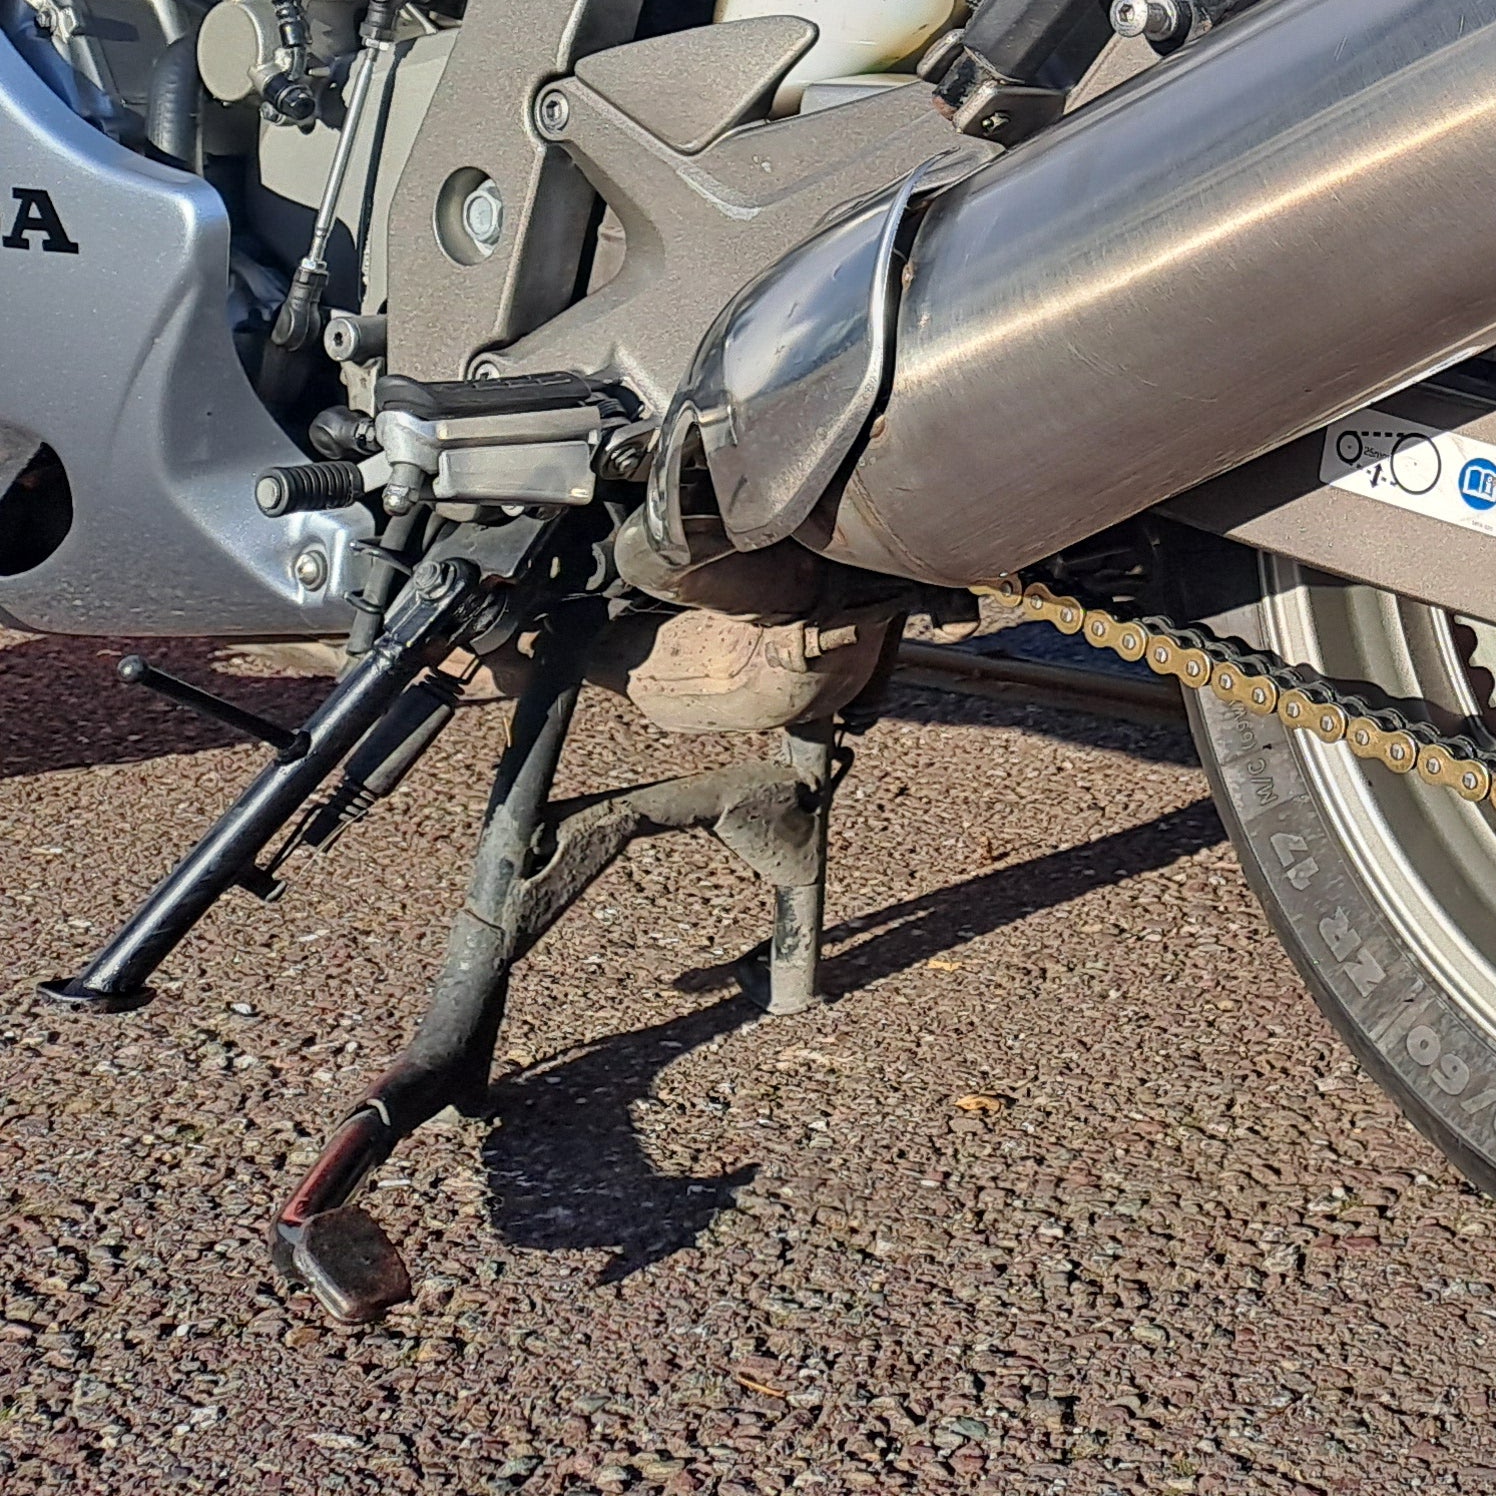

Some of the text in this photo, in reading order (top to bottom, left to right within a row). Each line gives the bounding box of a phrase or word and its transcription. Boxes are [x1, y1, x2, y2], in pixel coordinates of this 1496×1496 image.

[1245, 757, 1278, 806] M/C
[1268, 830, 1321, 892] 17
[1317, 906, 1387, 999] ZR
